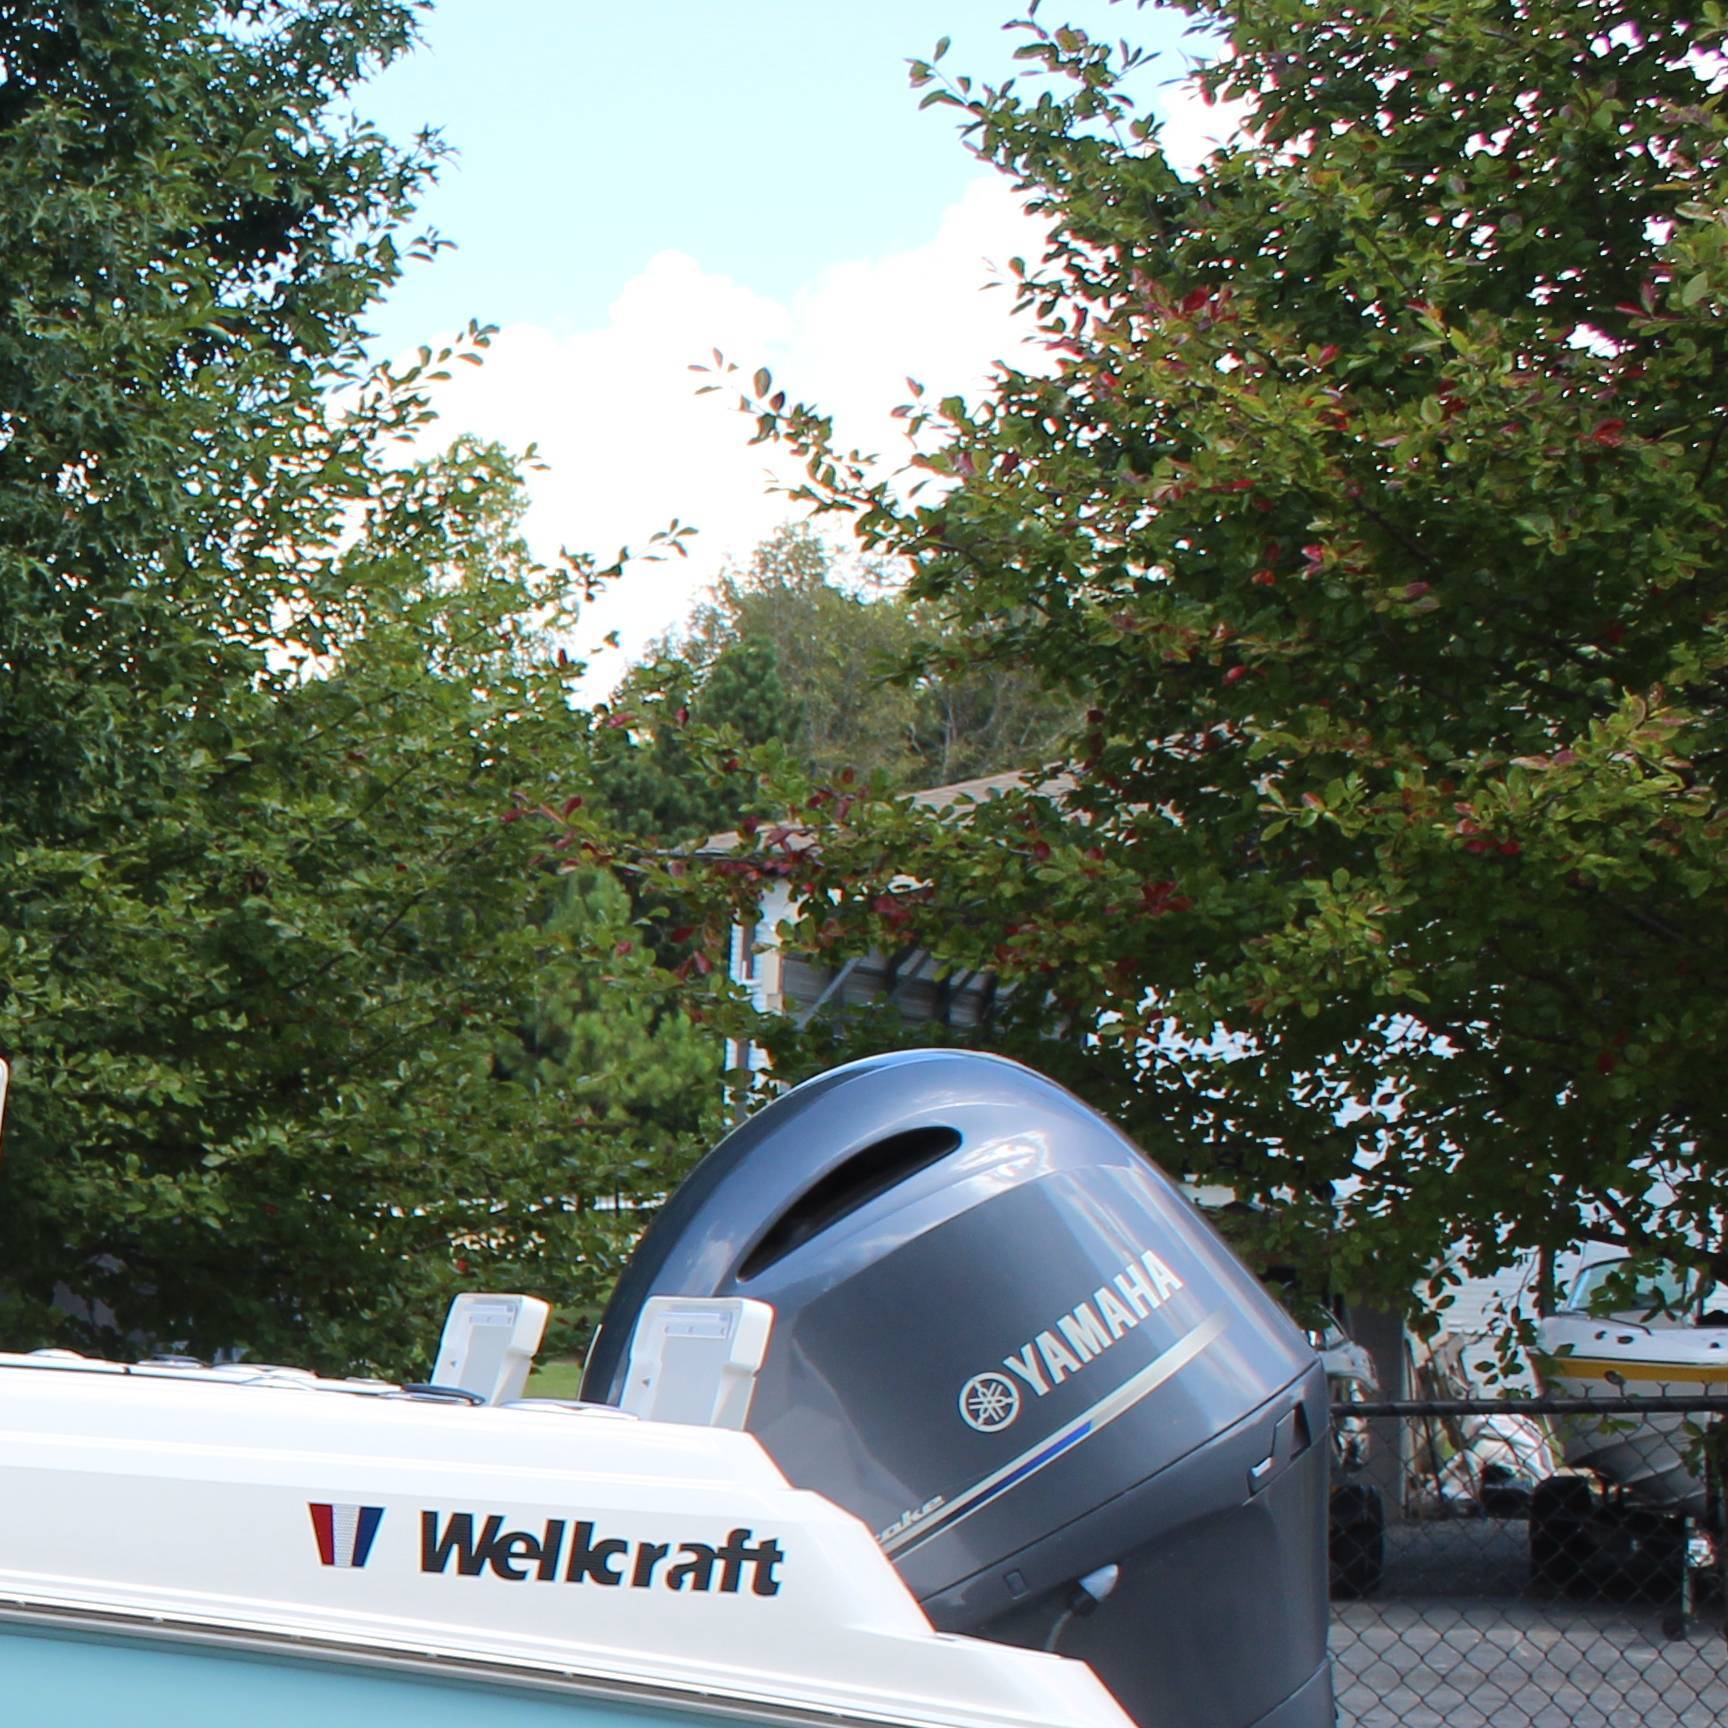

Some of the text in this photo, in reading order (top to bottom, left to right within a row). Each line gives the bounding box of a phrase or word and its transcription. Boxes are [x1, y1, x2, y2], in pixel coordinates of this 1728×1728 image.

[1002, 1249, 1184, 1397] YAMAHA
[419, 1509, 785, 1597] Wellcraft
[876, 1495, 944, 1544] oke
